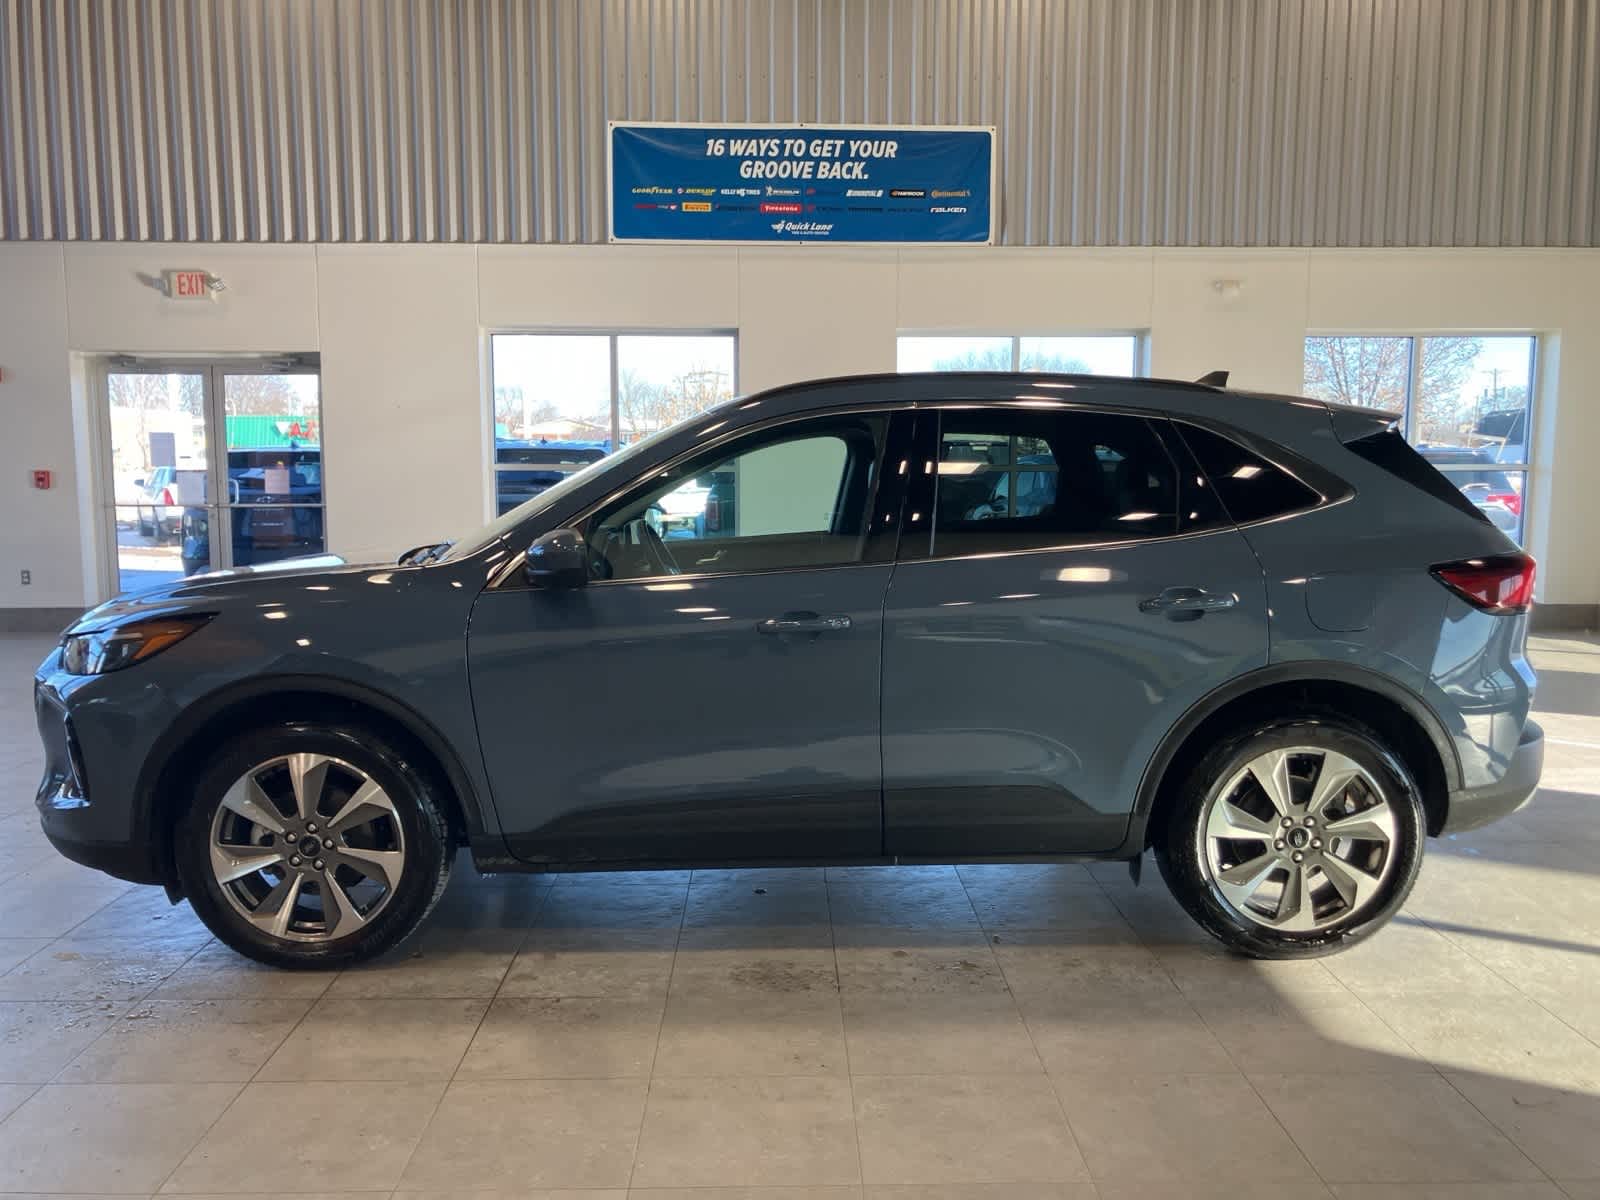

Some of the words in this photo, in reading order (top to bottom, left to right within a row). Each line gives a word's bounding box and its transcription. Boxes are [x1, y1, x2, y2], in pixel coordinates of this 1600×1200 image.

[705, 139, 725, 157] 16
[729, 139, 780, 157] WAYS
[783, 139, 806, 157] TO
[809, 140, 844, 158] GET
[849, 140, 898, 158] YOUR
[740, 160, 814, 179] GROOVE
[816, 161, 869, 180] BACK.
[785, 222, 809, 231] Quick
[809, 222, 833, 231] Lane
[177, 273, 206, 296] EXIT
